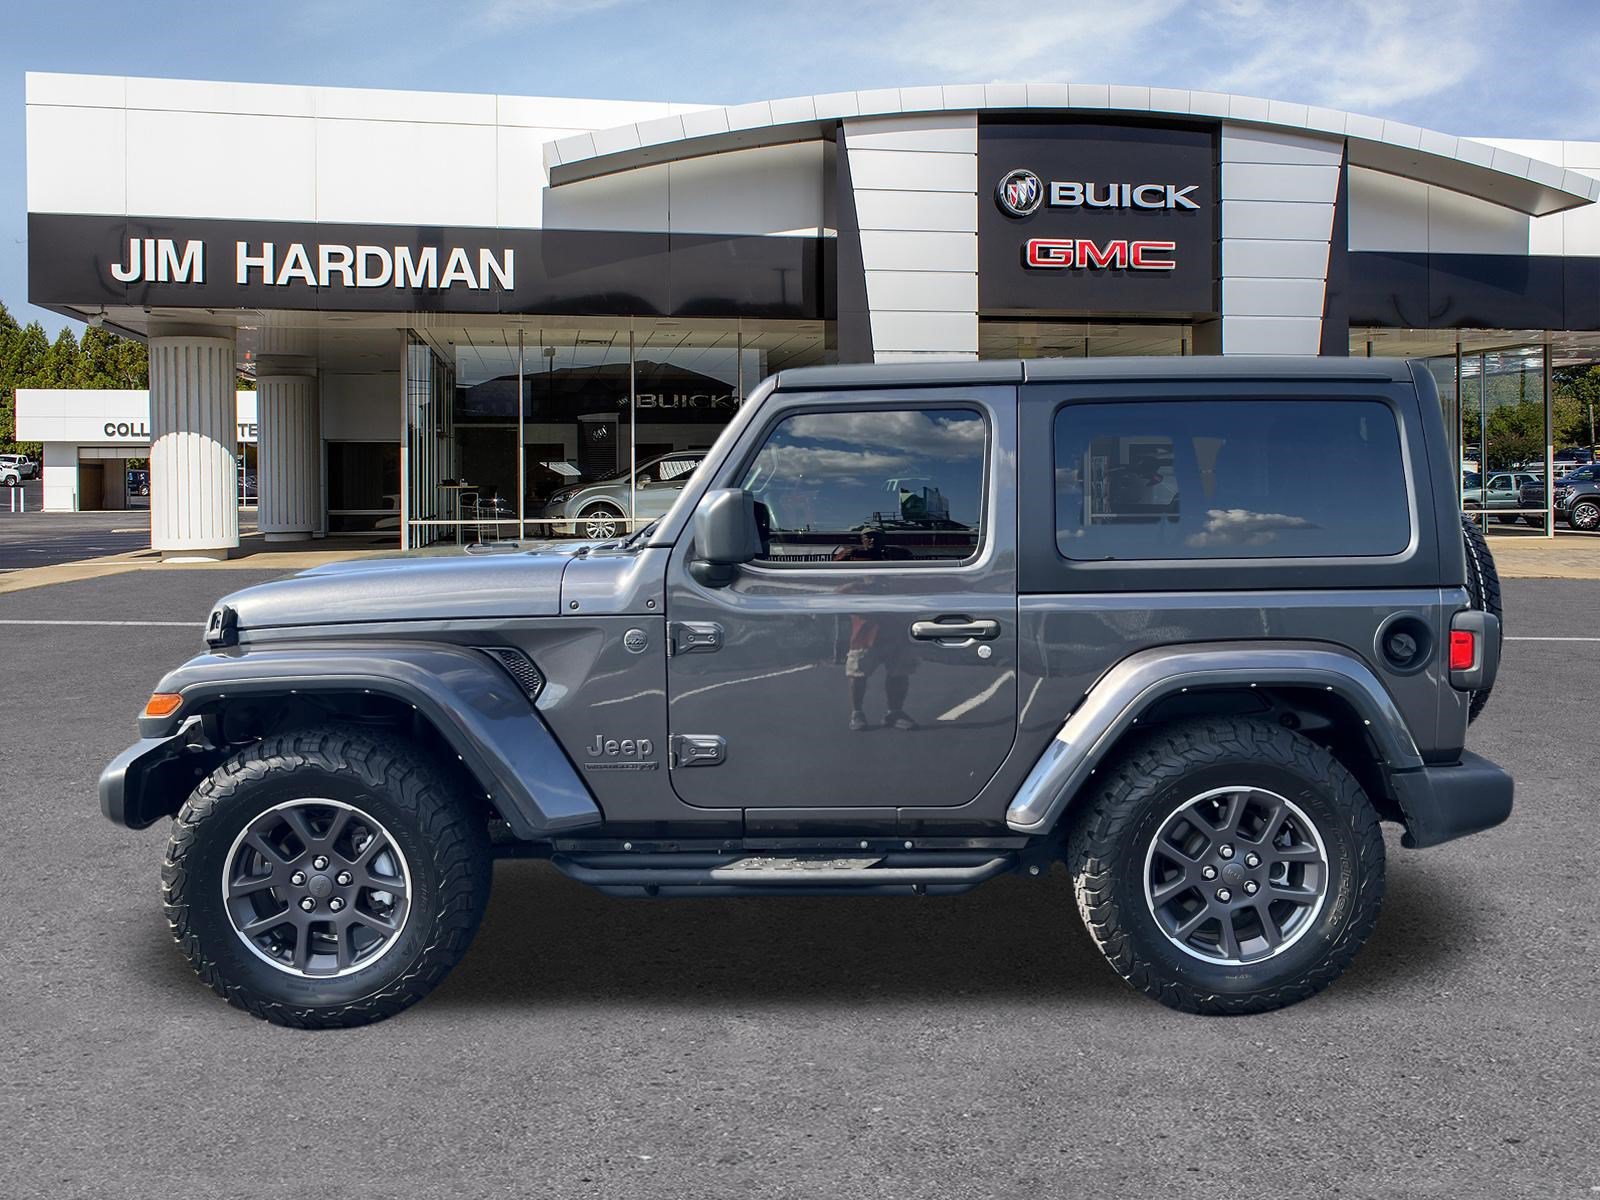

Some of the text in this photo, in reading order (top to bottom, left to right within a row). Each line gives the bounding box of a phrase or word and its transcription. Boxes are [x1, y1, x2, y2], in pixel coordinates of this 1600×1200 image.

[1050, 181, 1201, 209] BUICK
[111, 238, 516, 291] JIM HARDMAN
[1026, 238, 1176, 270] GMC
[636, 394, 732, 409] BUICK
[585, 734, 654, 760] Jeep
